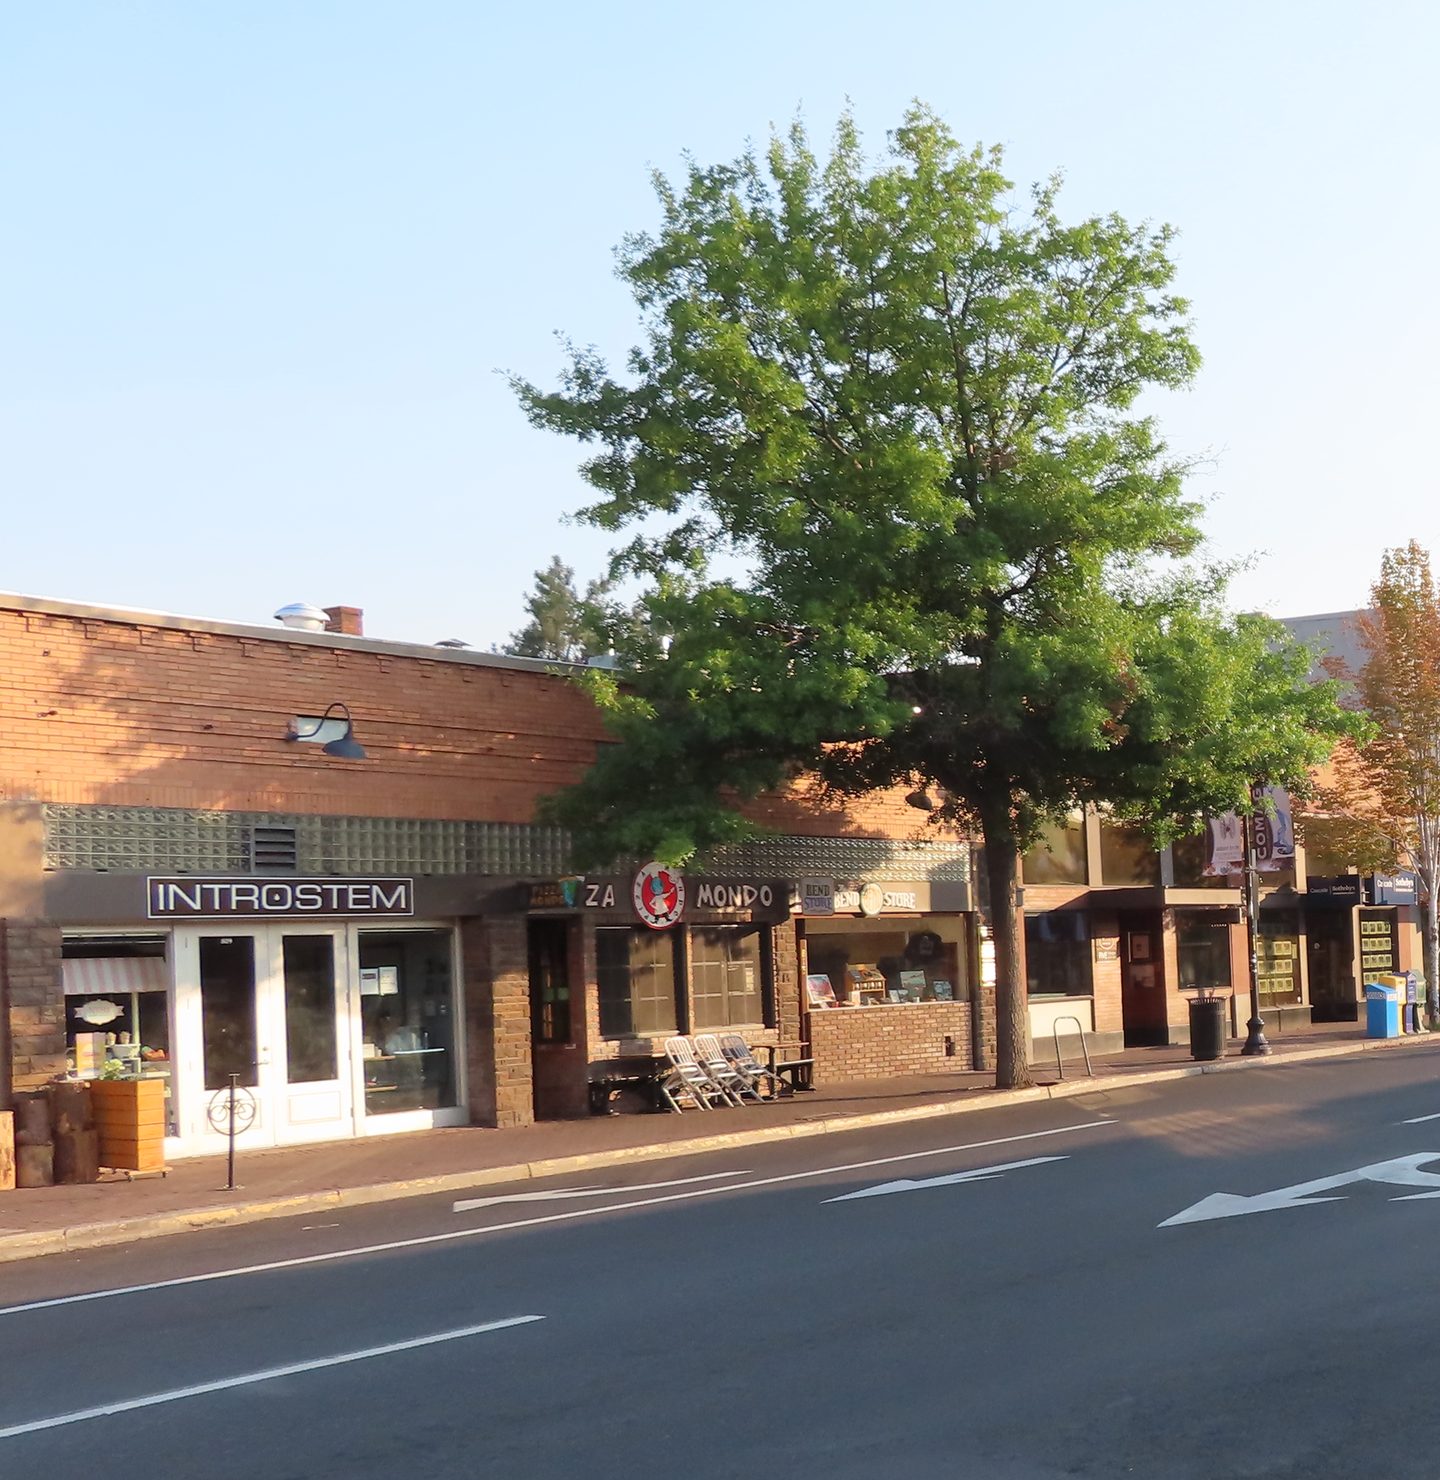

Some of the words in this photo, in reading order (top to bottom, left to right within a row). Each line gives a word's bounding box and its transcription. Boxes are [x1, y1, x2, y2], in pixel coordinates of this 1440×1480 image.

[157, 884, 407, 911] INTROSTEM
[697, 883, 773, 908] MONDO
[806, 884, 830, 896] BEND
[834, 890, 860, 908] BEND
[883, 891, 917, 910] STORE
[804, 897, 832, 910] STORE
